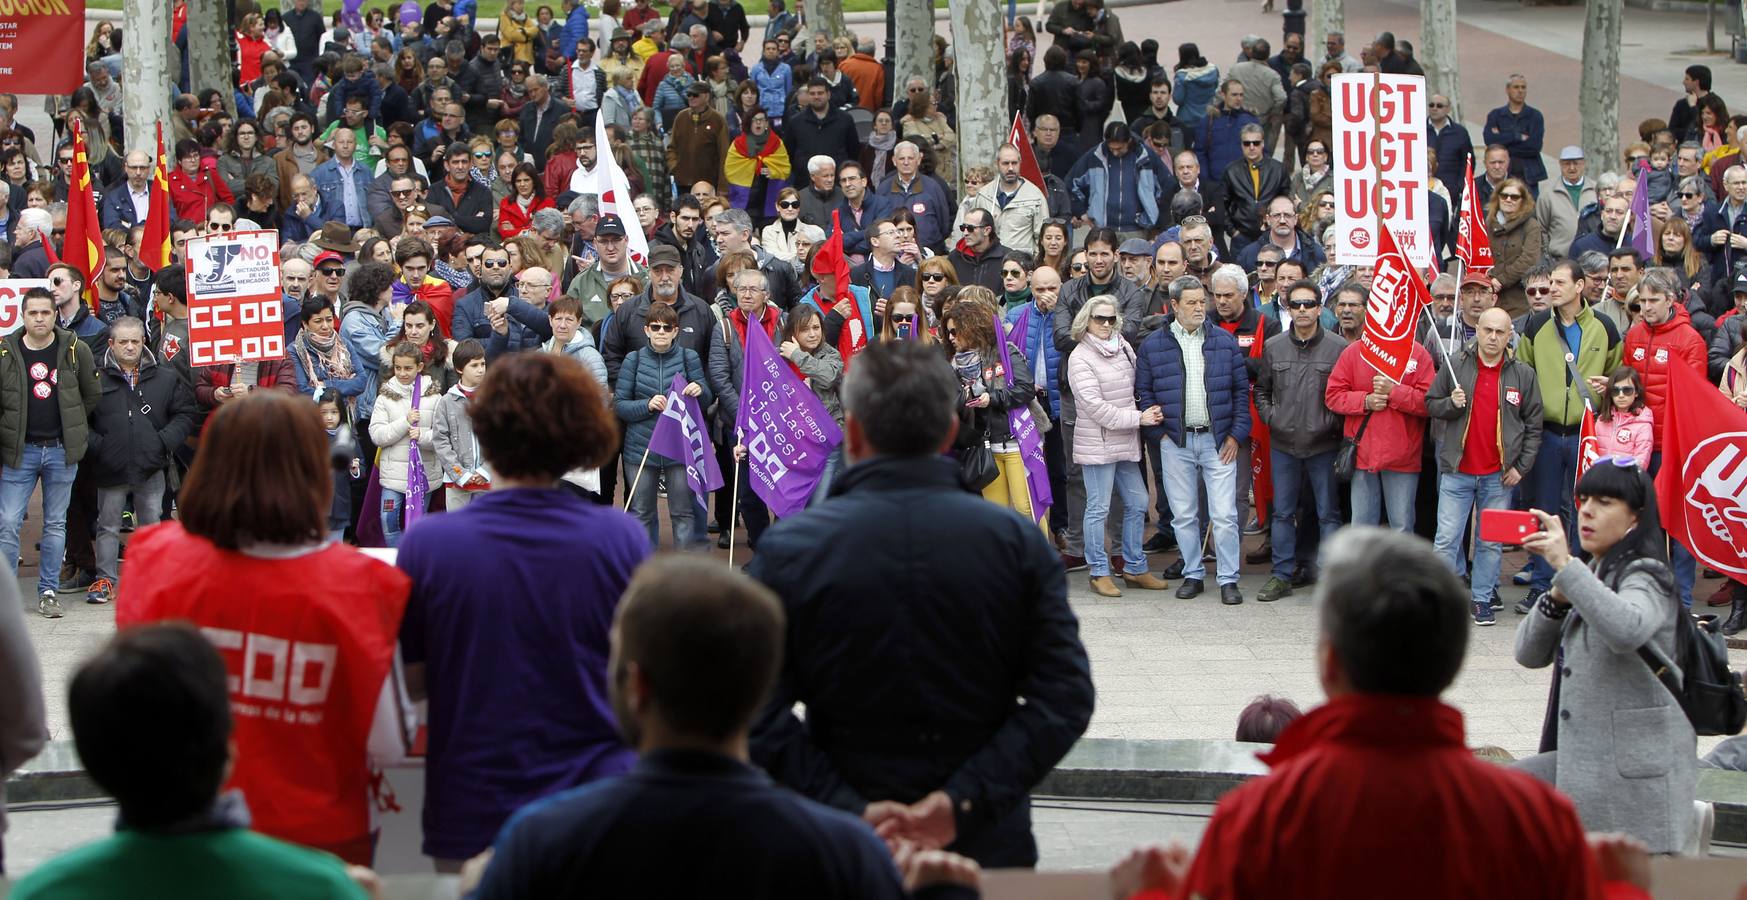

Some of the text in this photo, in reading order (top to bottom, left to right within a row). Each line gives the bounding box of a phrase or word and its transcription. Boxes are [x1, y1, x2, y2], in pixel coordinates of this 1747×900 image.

[1342, 82, 1416, 124] UGT
[1343, 130, 1418, 172] UGT
[1344, 178, 1419, 221] UGT
[240, 244, 269, 261] NO
[1367, 258, 1402, 327] UGT
[761, 380, 806, 441] de las
[781, 383, 796, 399] el
[795, 401, 828, 444] tiempo
